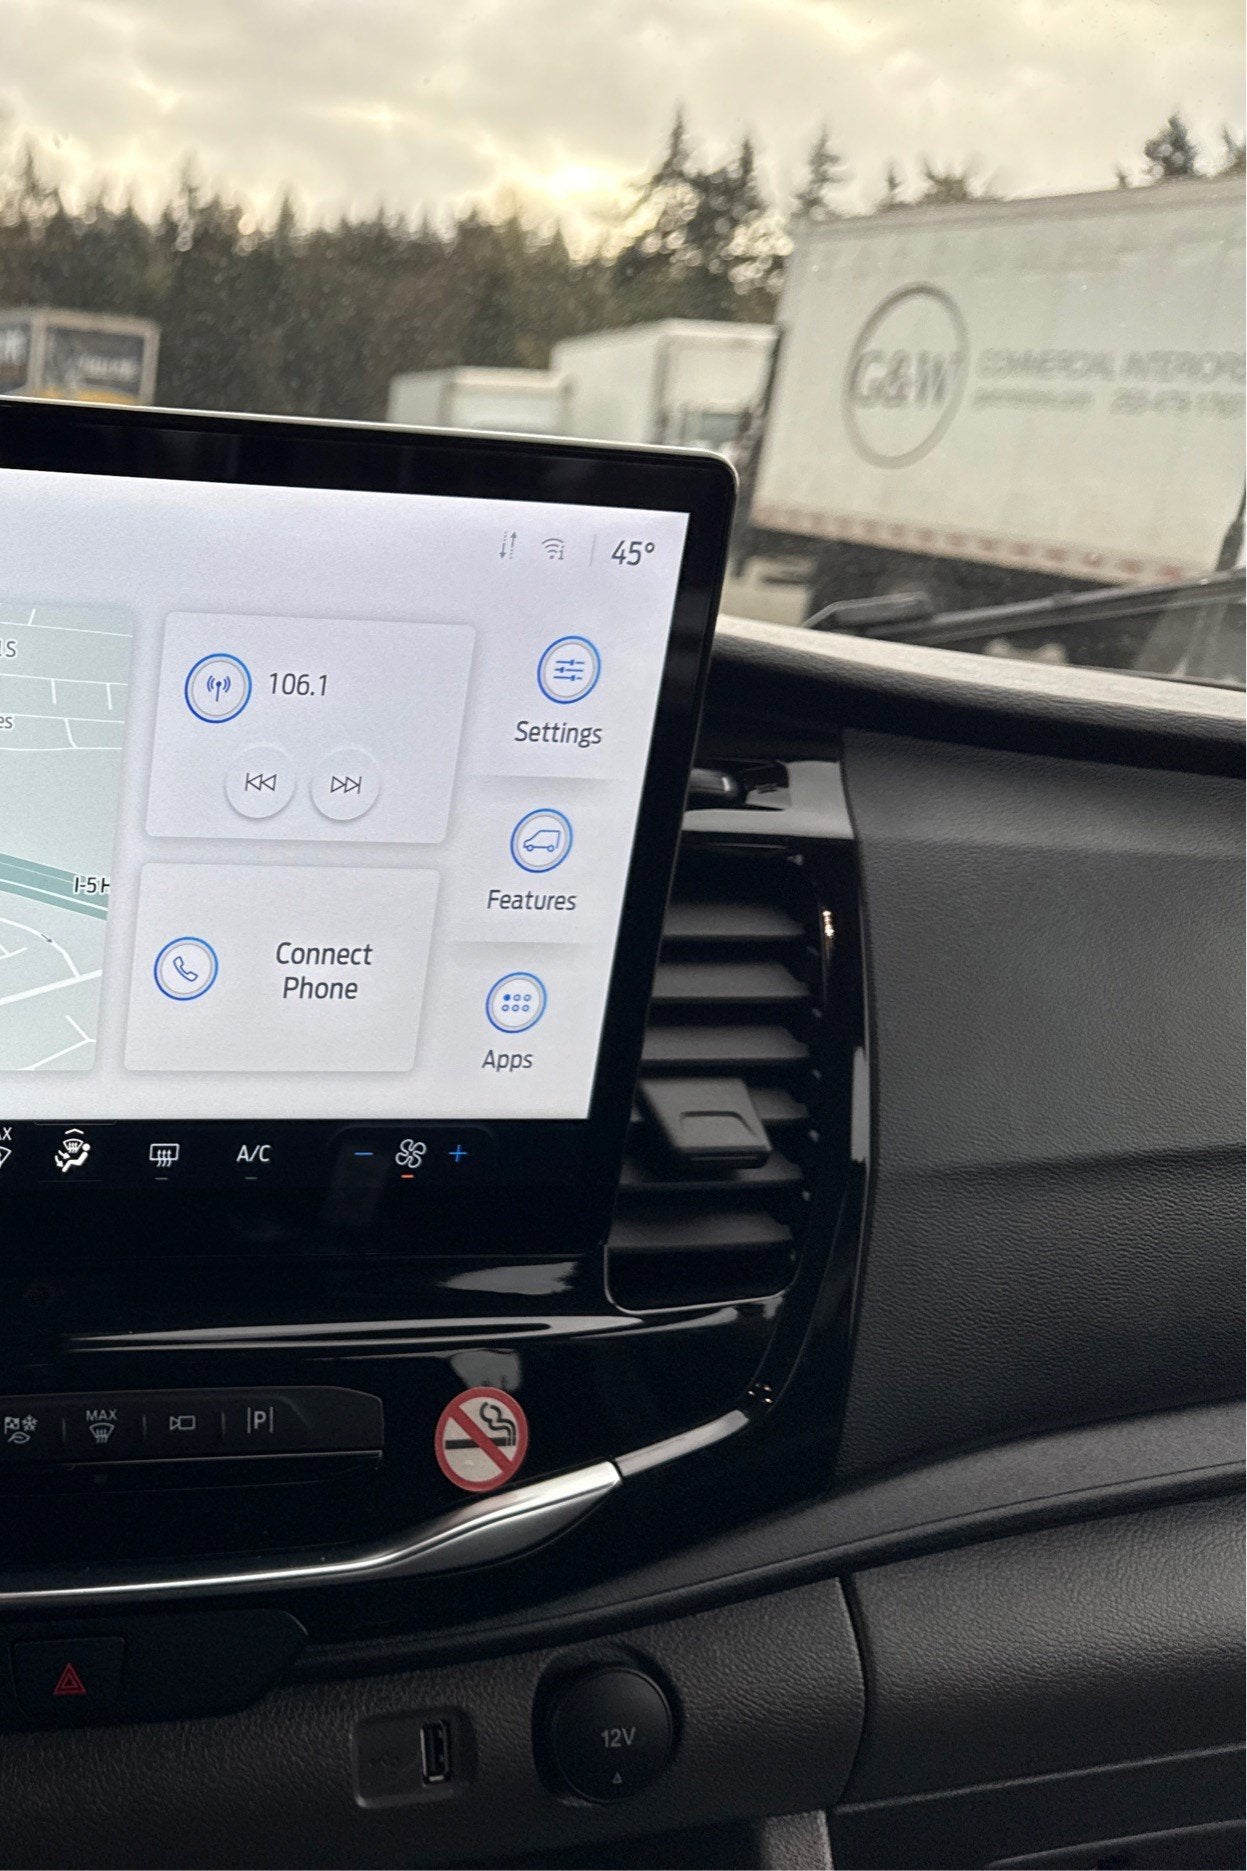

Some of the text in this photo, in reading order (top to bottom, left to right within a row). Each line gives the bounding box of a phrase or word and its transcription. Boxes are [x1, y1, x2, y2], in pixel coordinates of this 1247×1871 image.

[854, 349, 962, 408] G&W
[611, 539, 656, 566] 45°
[5, 640, 16, 658] S
[269, 671, 329, 696] 106.1
[514, 720, 603, 749] Settings
[74, 876, 97, 894] I-5
[486, 889, 578, 911] Features
[275, 941, 373, 966] Connect
[282, 976, 358, 1000] Phone
[481, 1049, 533, 1073] Apps
[236, 1145, 272, 1162] A/C
[85, 1408, 118, 1422] MAX
[601, 1726, 636, 1748] 12V
